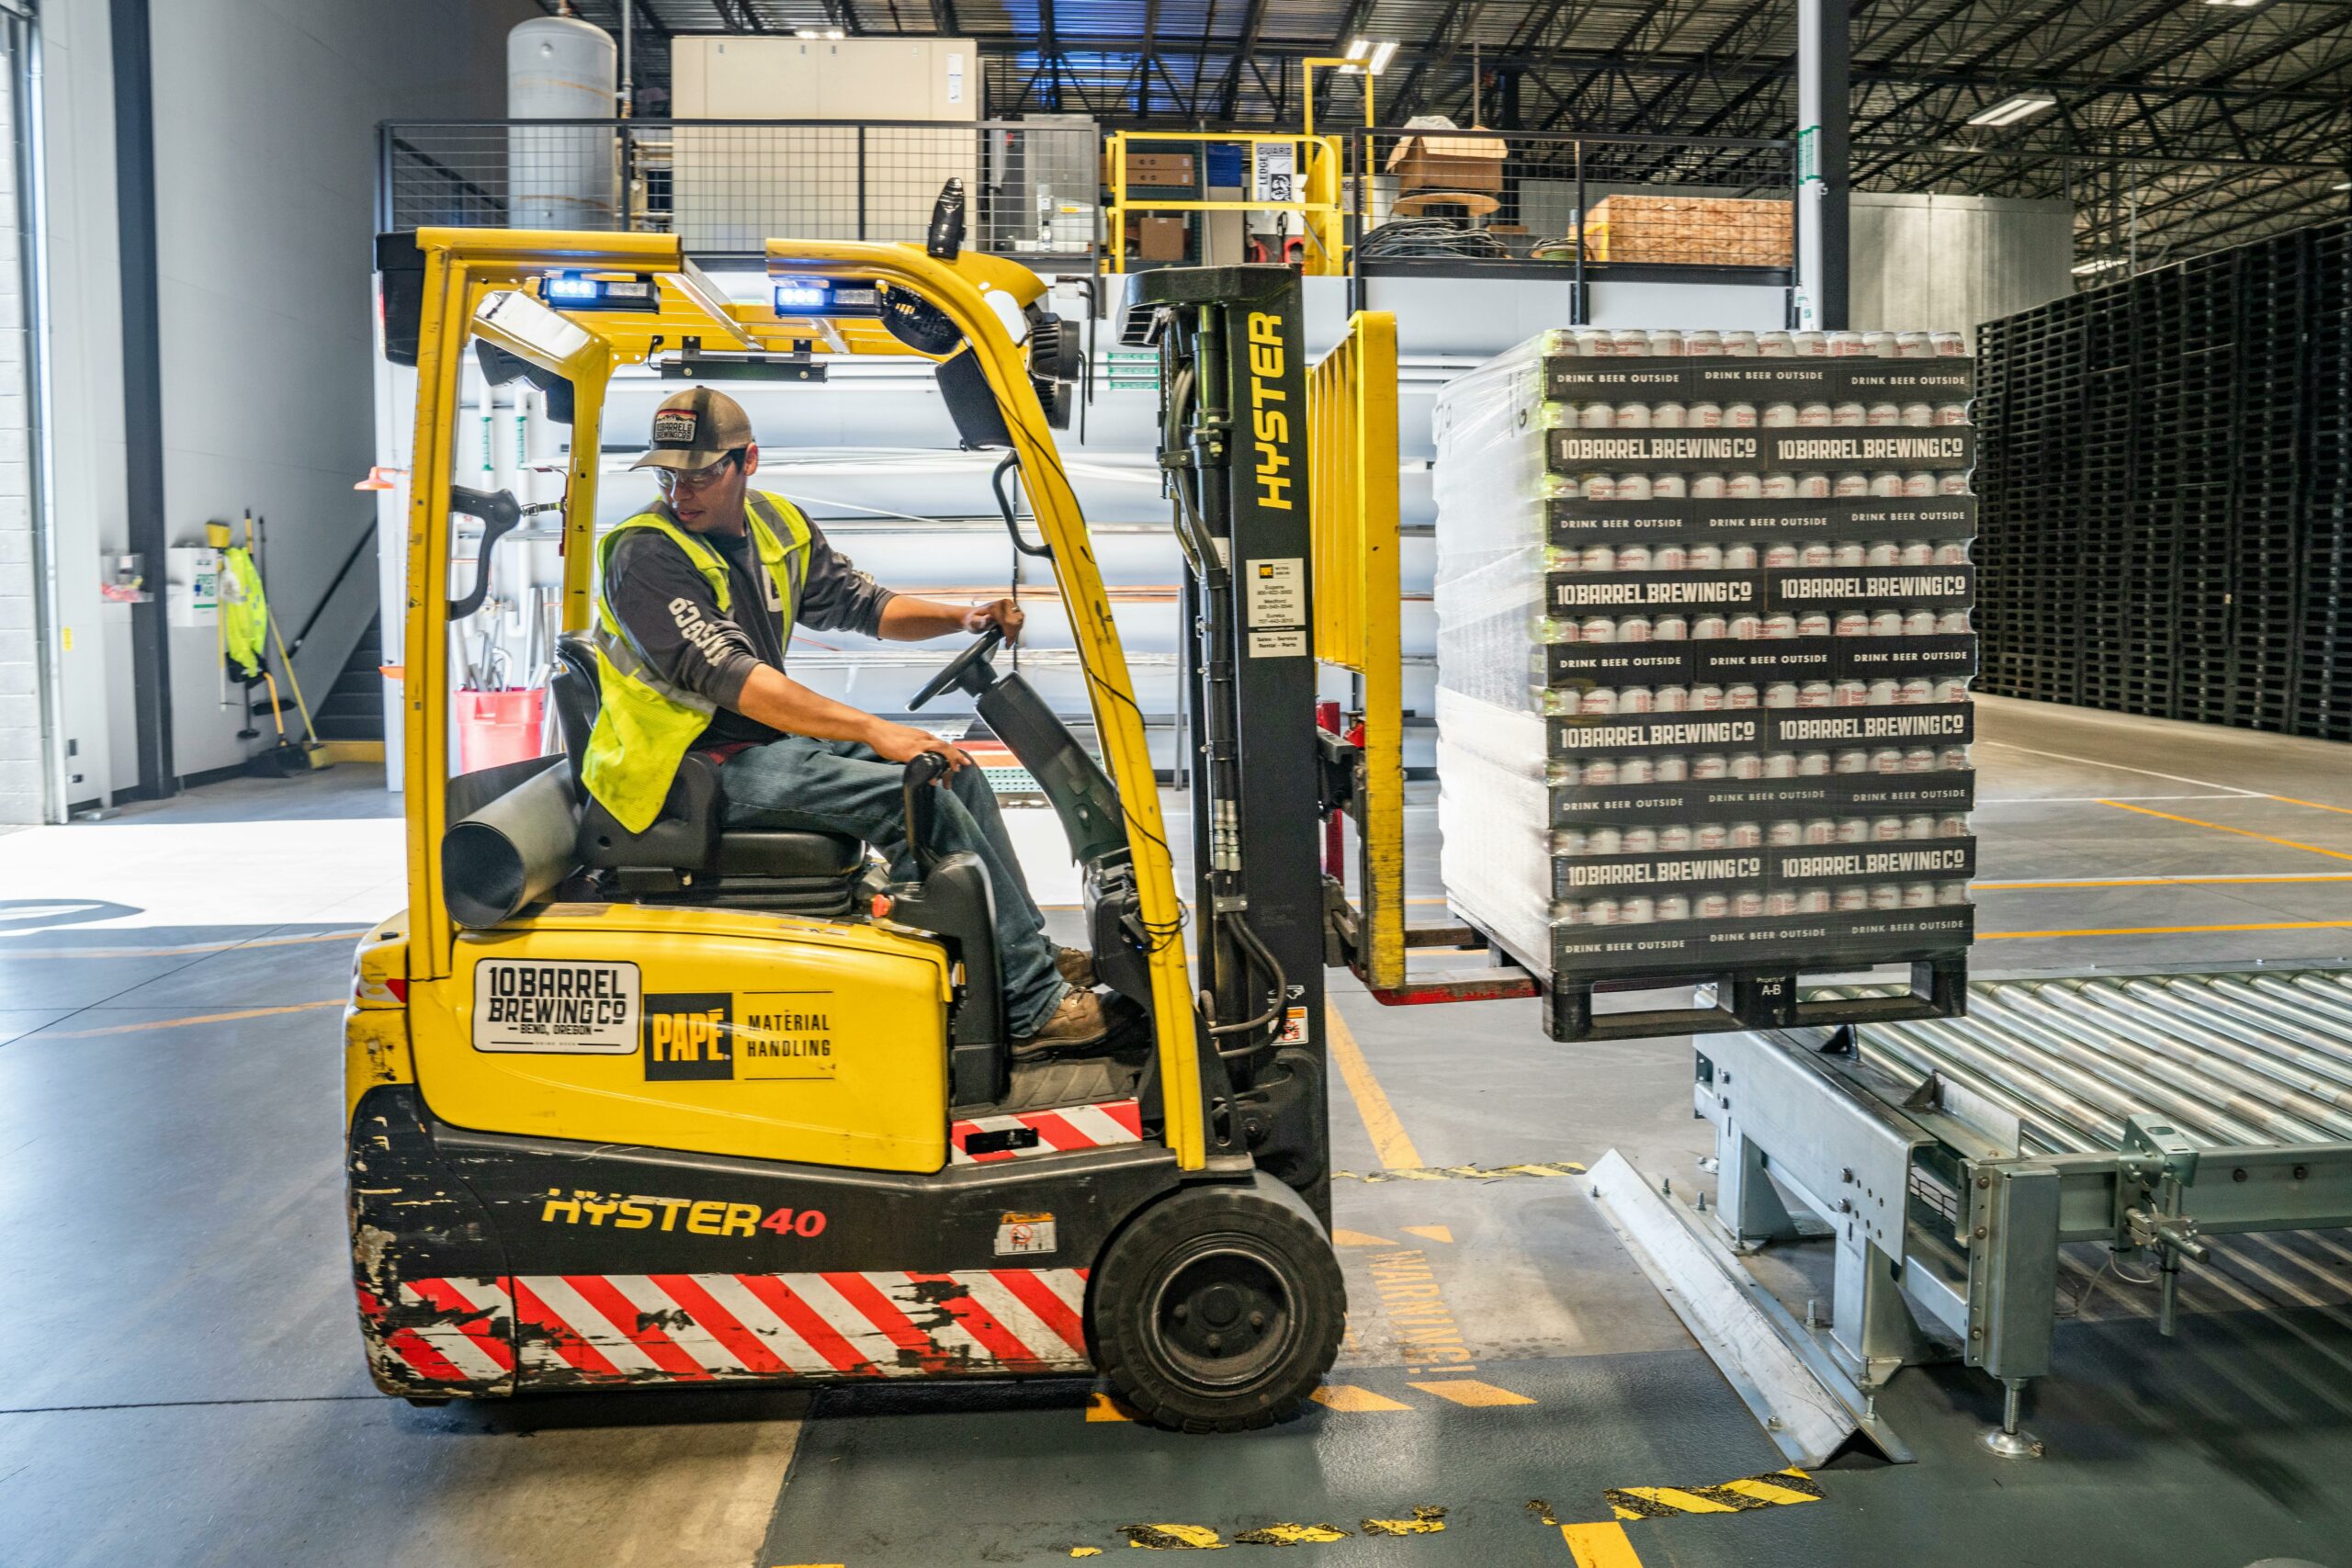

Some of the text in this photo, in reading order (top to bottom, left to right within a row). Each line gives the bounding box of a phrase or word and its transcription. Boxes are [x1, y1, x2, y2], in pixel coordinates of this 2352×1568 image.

[1259, 156, 1268, 185] LEDGE
[1556, 374, 1679, 383] DRINK BEER OUTSIDE
[1704, 371, 1823, 380] DRINK BEER OUTSIDE
[1851, 376, 1966, 385] DRINK BEER OUTSIDE
[1248, 310, 1293, 511] HYSTER
[1709, 517, 1827, 527] DRINK BEER OUTSIDE
[1851, 512, 1965, 522] DRINK BEER OUTSIDE
[1560, 519, 1682, 529] DRINK BEER OUTSIDE
[1559, 656, 1681, 669] DRINK BEER OUTSIDE
[1710, 654, 1827, 666] DRINK BEER OUTSIDE
[1853, 651, 1967, 662] DRINK BEER OUTSIDE
[1708, 790, 1825, 803] DRINK BEER OUTSIDE
[1852, 789, 1965, 802] DRINK BEER OUTSIDE
[1562, 797, 1683, 811] DRINK BEER OUTSIDE
[1850, 919, 1963, 934] DRINK BEER OUTSIDE
[1709, 928, 1826, 942] DRINK BEER OUTSIDE
[1565, 940, 1685, 953] DRINK BEER OUTSIDE
[1761, 984, 1781, 996] A-B
[747, 1014, 831, 1031] MATERIAL
[553, 1024, 592, 1035] OREGON
[747, 1039, 831, 1057] HANDLING
[541, 1188, 827, 1237] HYSTER 40
